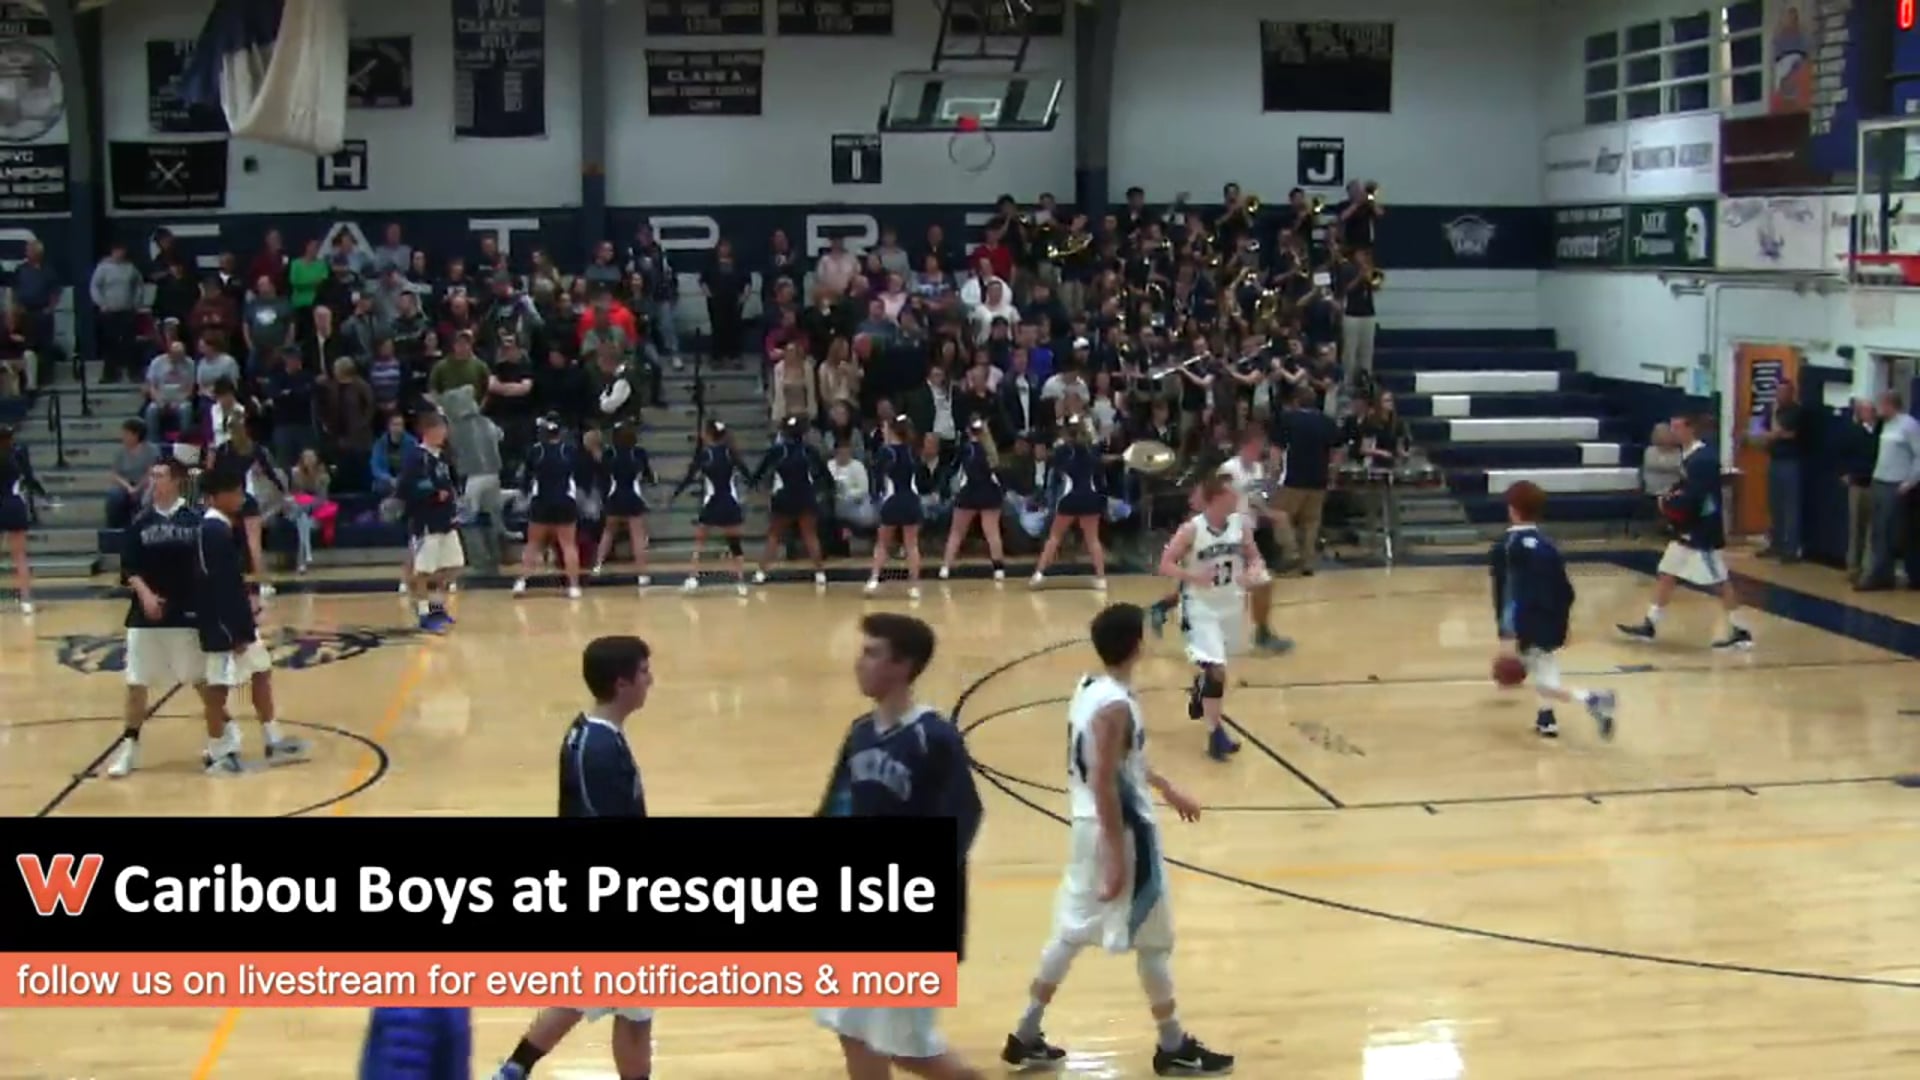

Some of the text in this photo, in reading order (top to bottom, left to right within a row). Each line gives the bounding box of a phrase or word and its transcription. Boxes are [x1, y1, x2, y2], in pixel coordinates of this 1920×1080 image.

[324, 156, 361, 186] H
[852, 149, 861, 180] I
[1307, 153, 1335, 182] J
